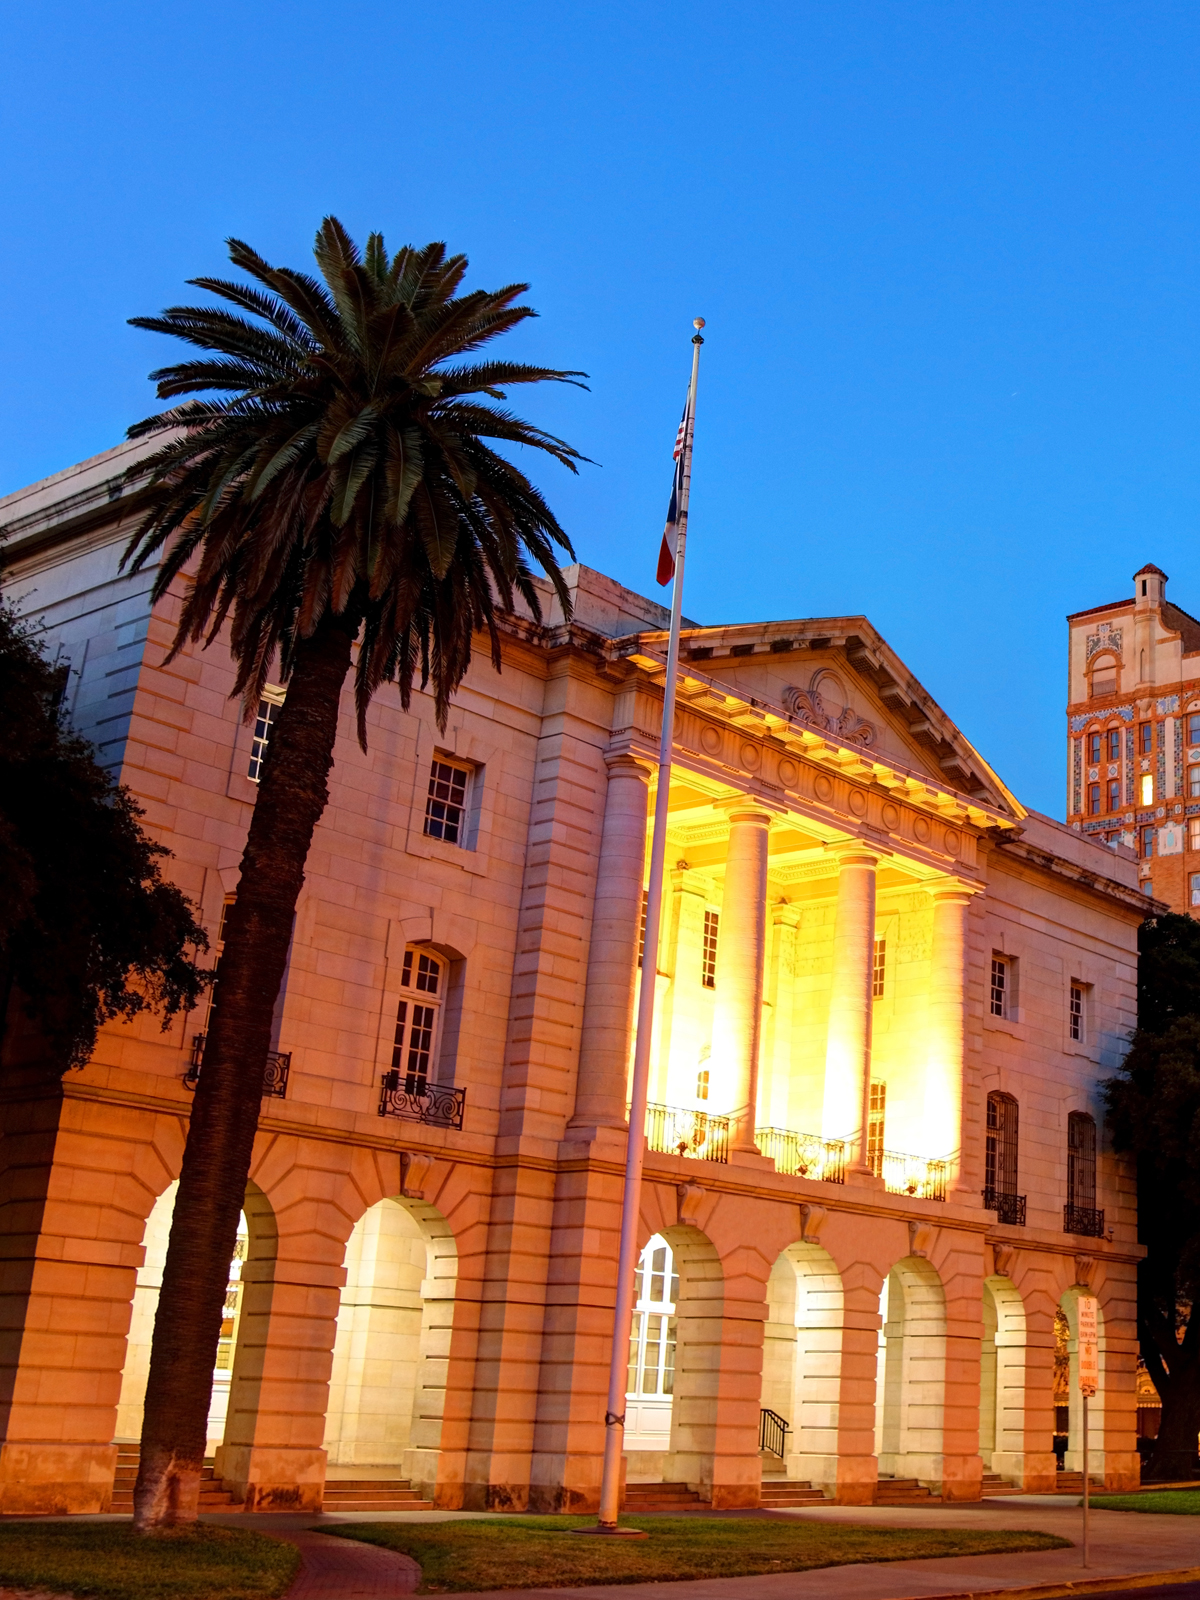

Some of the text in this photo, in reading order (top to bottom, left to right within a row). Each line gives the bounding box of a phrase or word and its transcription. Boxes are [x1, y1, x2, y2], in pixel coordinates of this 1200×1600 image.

[1084, 1300, 1091, 1310] 10
[1081, 1311, 1094, 1319] MINUTE
[1085, 1346, 1092, 1355] NO
[1081, 1360, 1096, 1370] DOUBLE
[1080, 1375, 1097, 1385] PARKING
